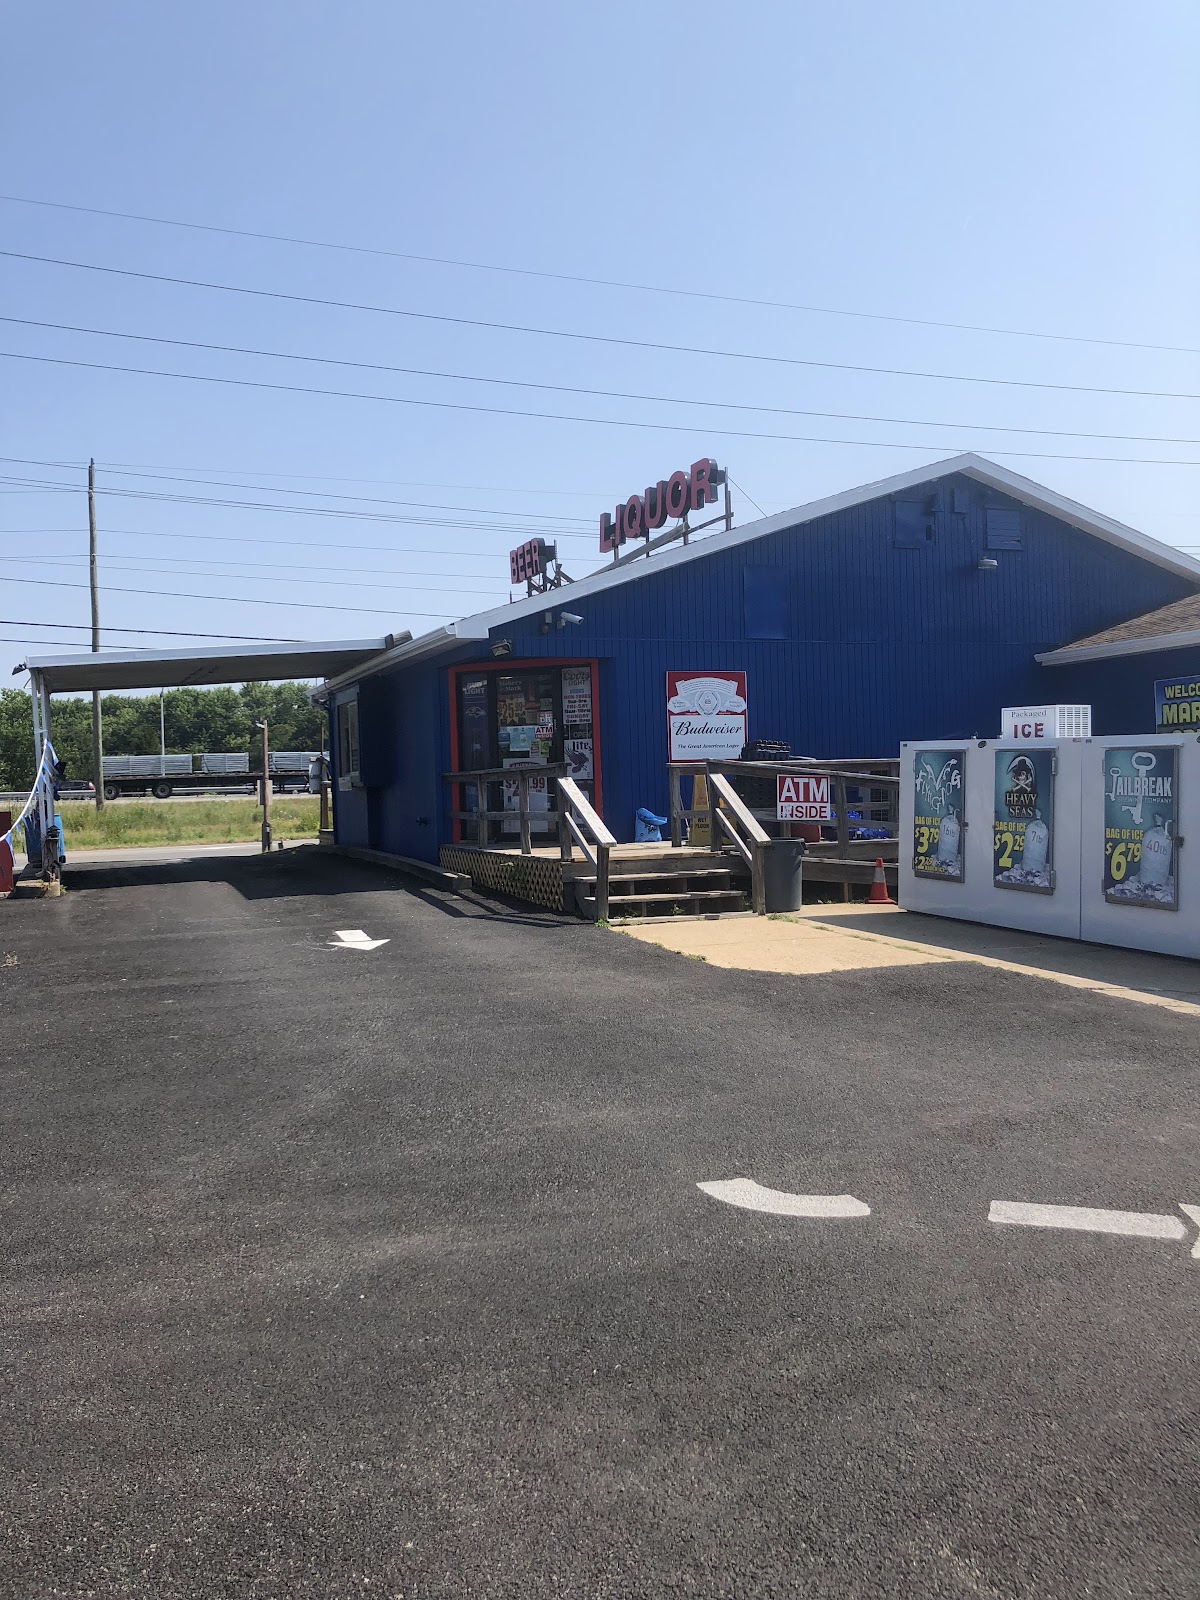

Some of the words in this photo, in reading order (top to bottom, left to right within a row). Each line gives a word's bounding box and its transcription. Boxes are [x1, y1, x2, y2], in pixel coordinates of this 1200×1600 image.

[600, 458, 715, 553] LIQUOR
[510, 538, 542, 584] BEER
[464, 687, 485, 695] LIGHT
[1011, 710, 1047, 718] Packaged
[672, 721, 742, 736] Budweiser
[1013, 722, 1044, 738] ICE
[780, 777, 828, 802] ATM
[1106, 769, 1172, 800] JAILBREAK
[1006, 793, 1037, 805] HEAVY
[780, 805, 828, 818] INSIDE
[1009, 806, 1033, 818] SEAS
[914, 816, 926, 825] BAG
[926, 817, 932, 825] OF
[932, 817, 941, 826] ICE
[995, 821, 1007, 831] BAG
[1008, 822, 1016, 831] OF
[1017, 823, 1026, 832] ICE
[1105, 828, 1120, 838] BAG
[1121, 829, 1130, 839] OF
[1131, 829, 1144, 840] ICE
